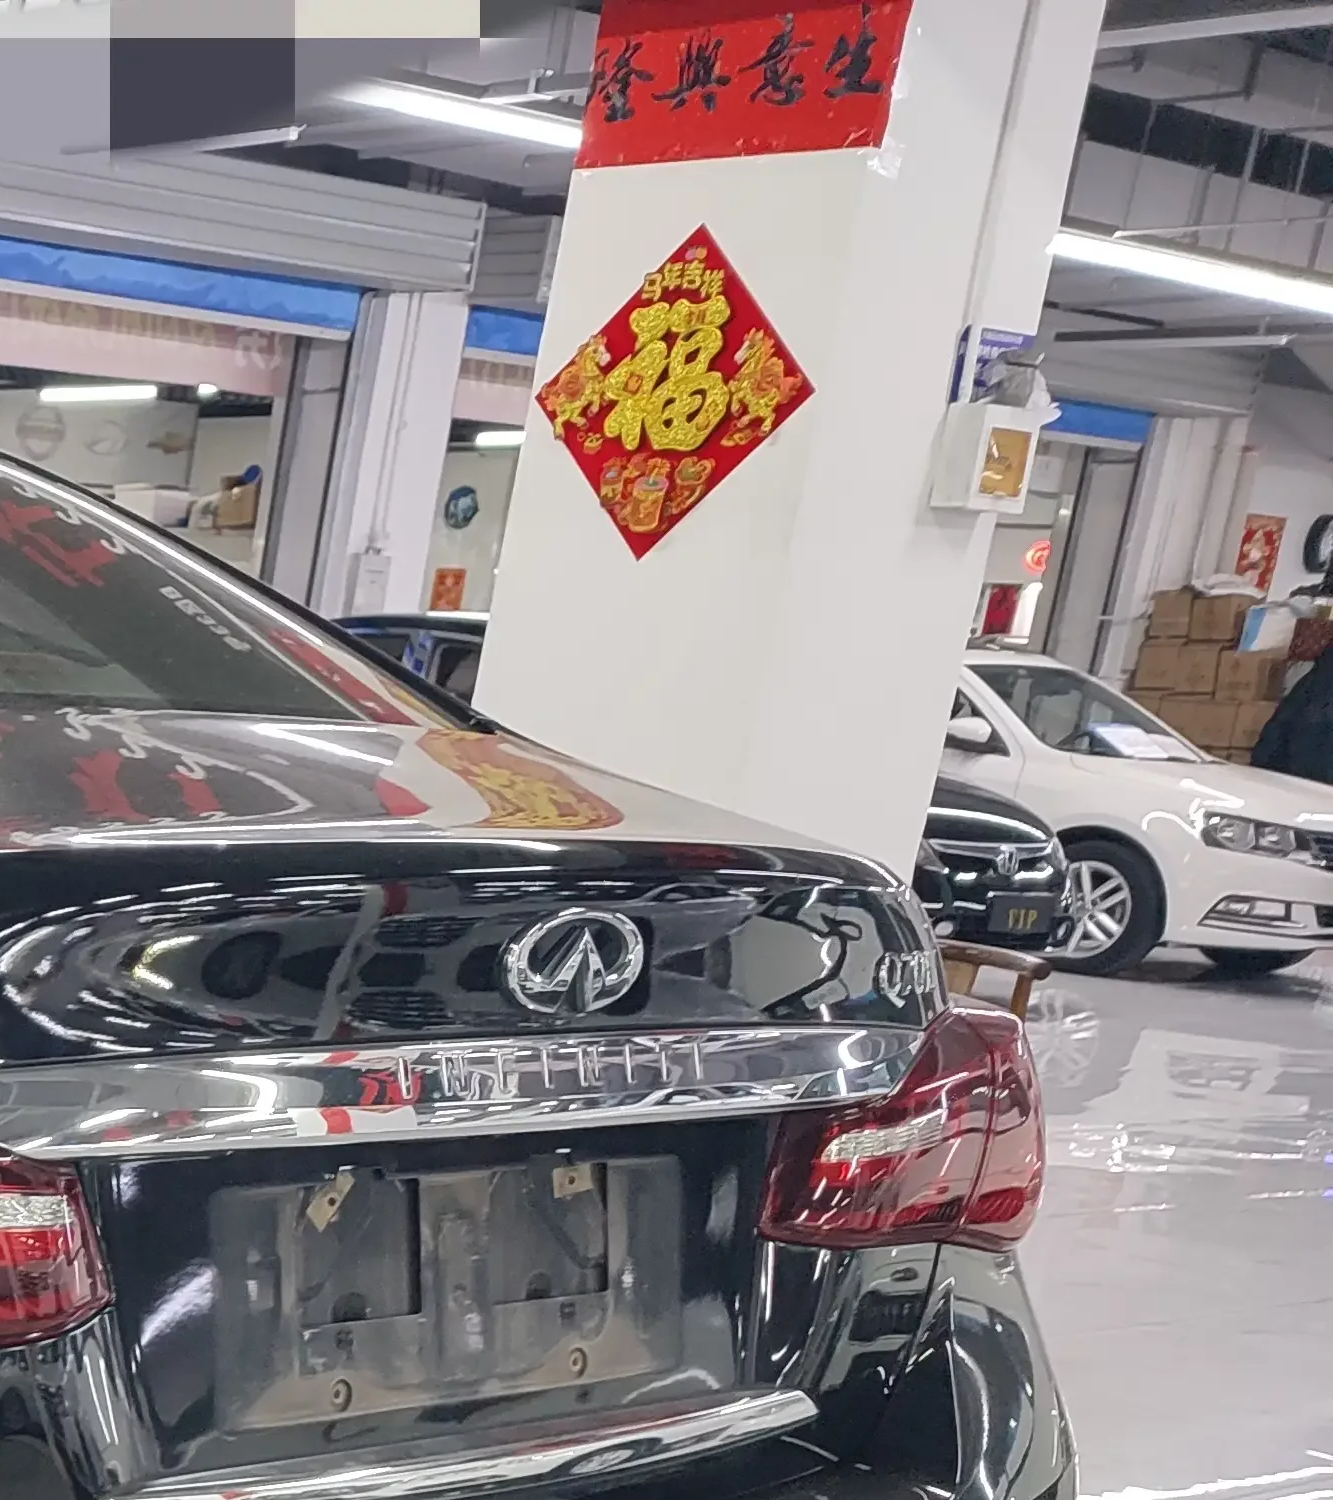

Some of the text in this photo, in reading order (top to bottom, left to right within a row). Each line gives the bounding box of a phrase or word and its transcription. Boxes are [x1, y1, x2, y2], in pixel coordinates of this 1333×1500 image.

[604, 295, 731, 451] 福
[1007, 907, 1039, 930] VIP
[396, 1042, 707, 1100] INFINITI
